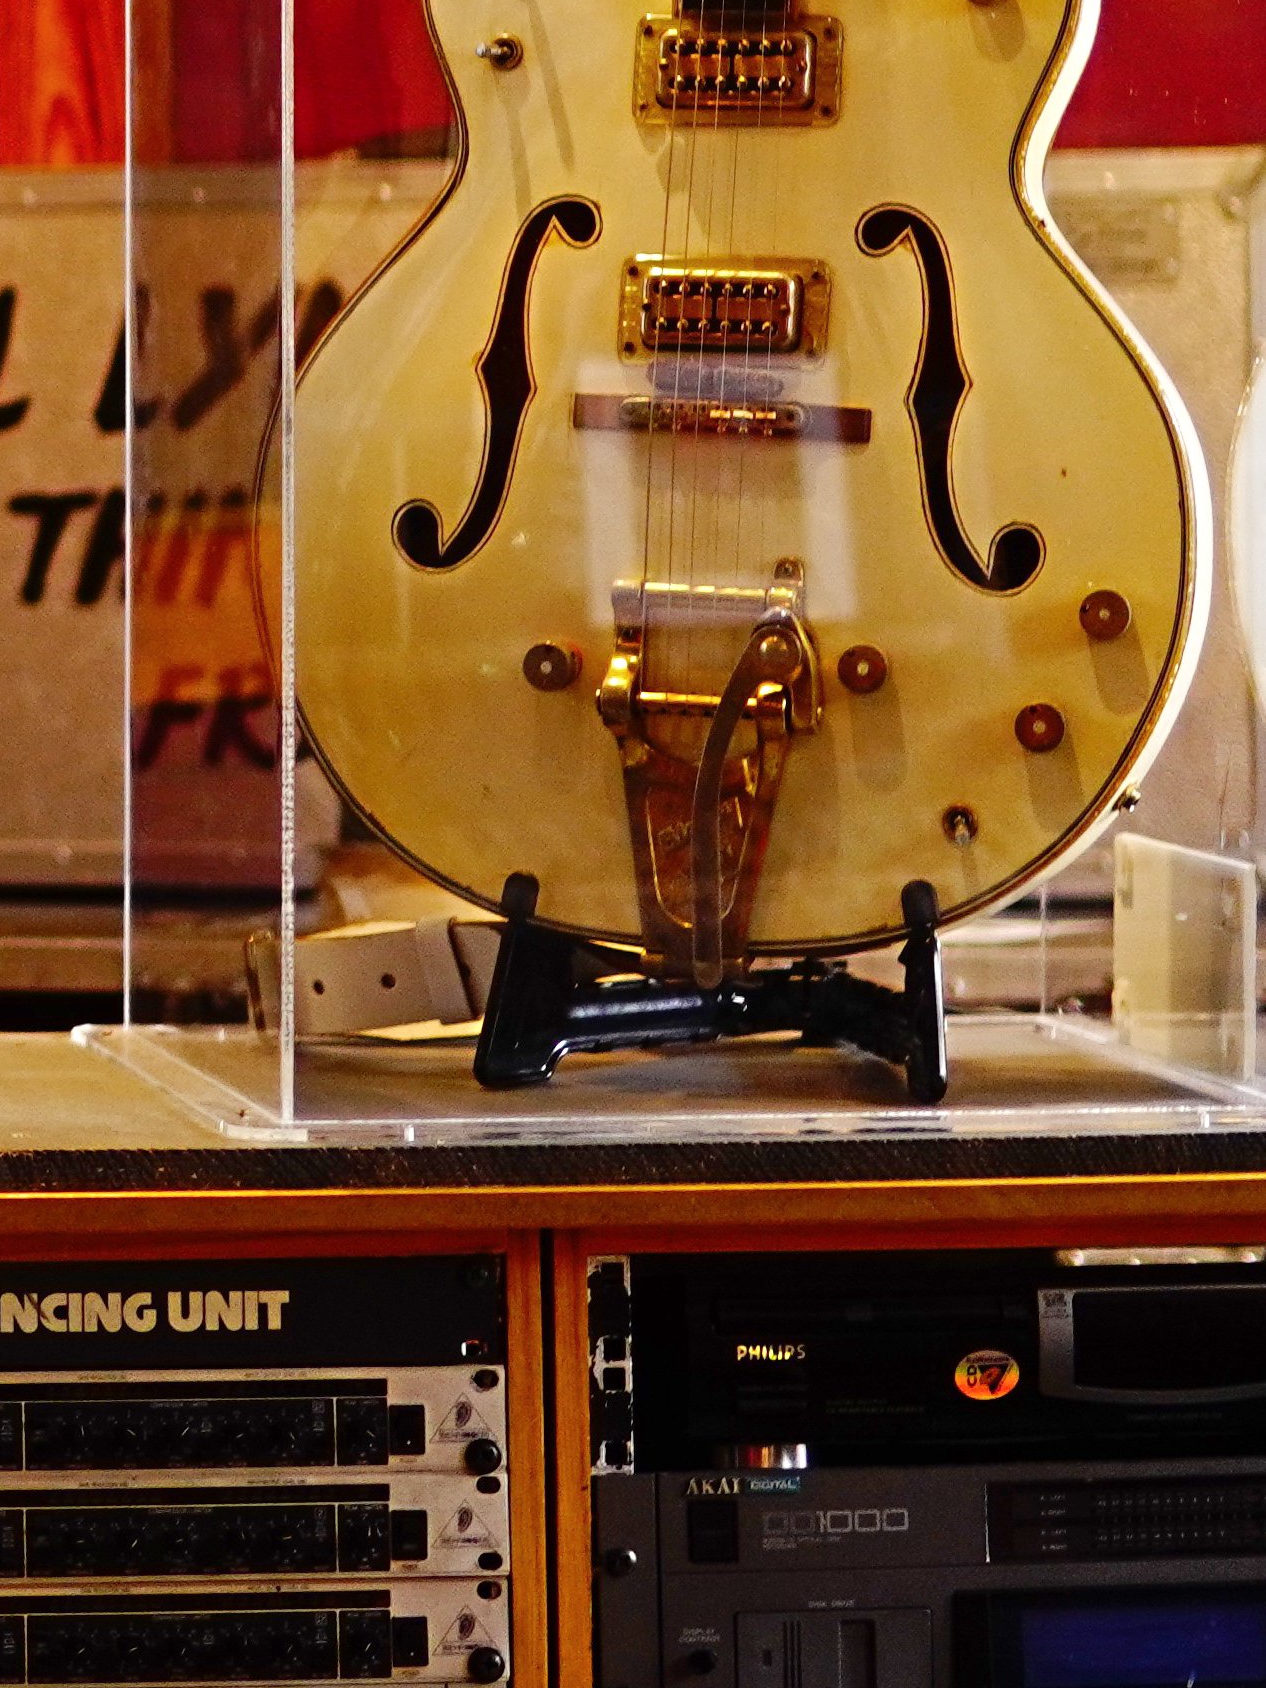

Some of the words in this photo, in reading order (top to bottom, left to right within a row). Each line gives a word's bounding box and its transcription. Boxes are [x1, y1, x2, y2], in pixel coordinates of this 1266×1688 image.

[167, 1289, 291, 1332] UNIT
[736, 1344, 806, 1362] PHILIPS
[686, 1476, 742, 1495] AKAI
